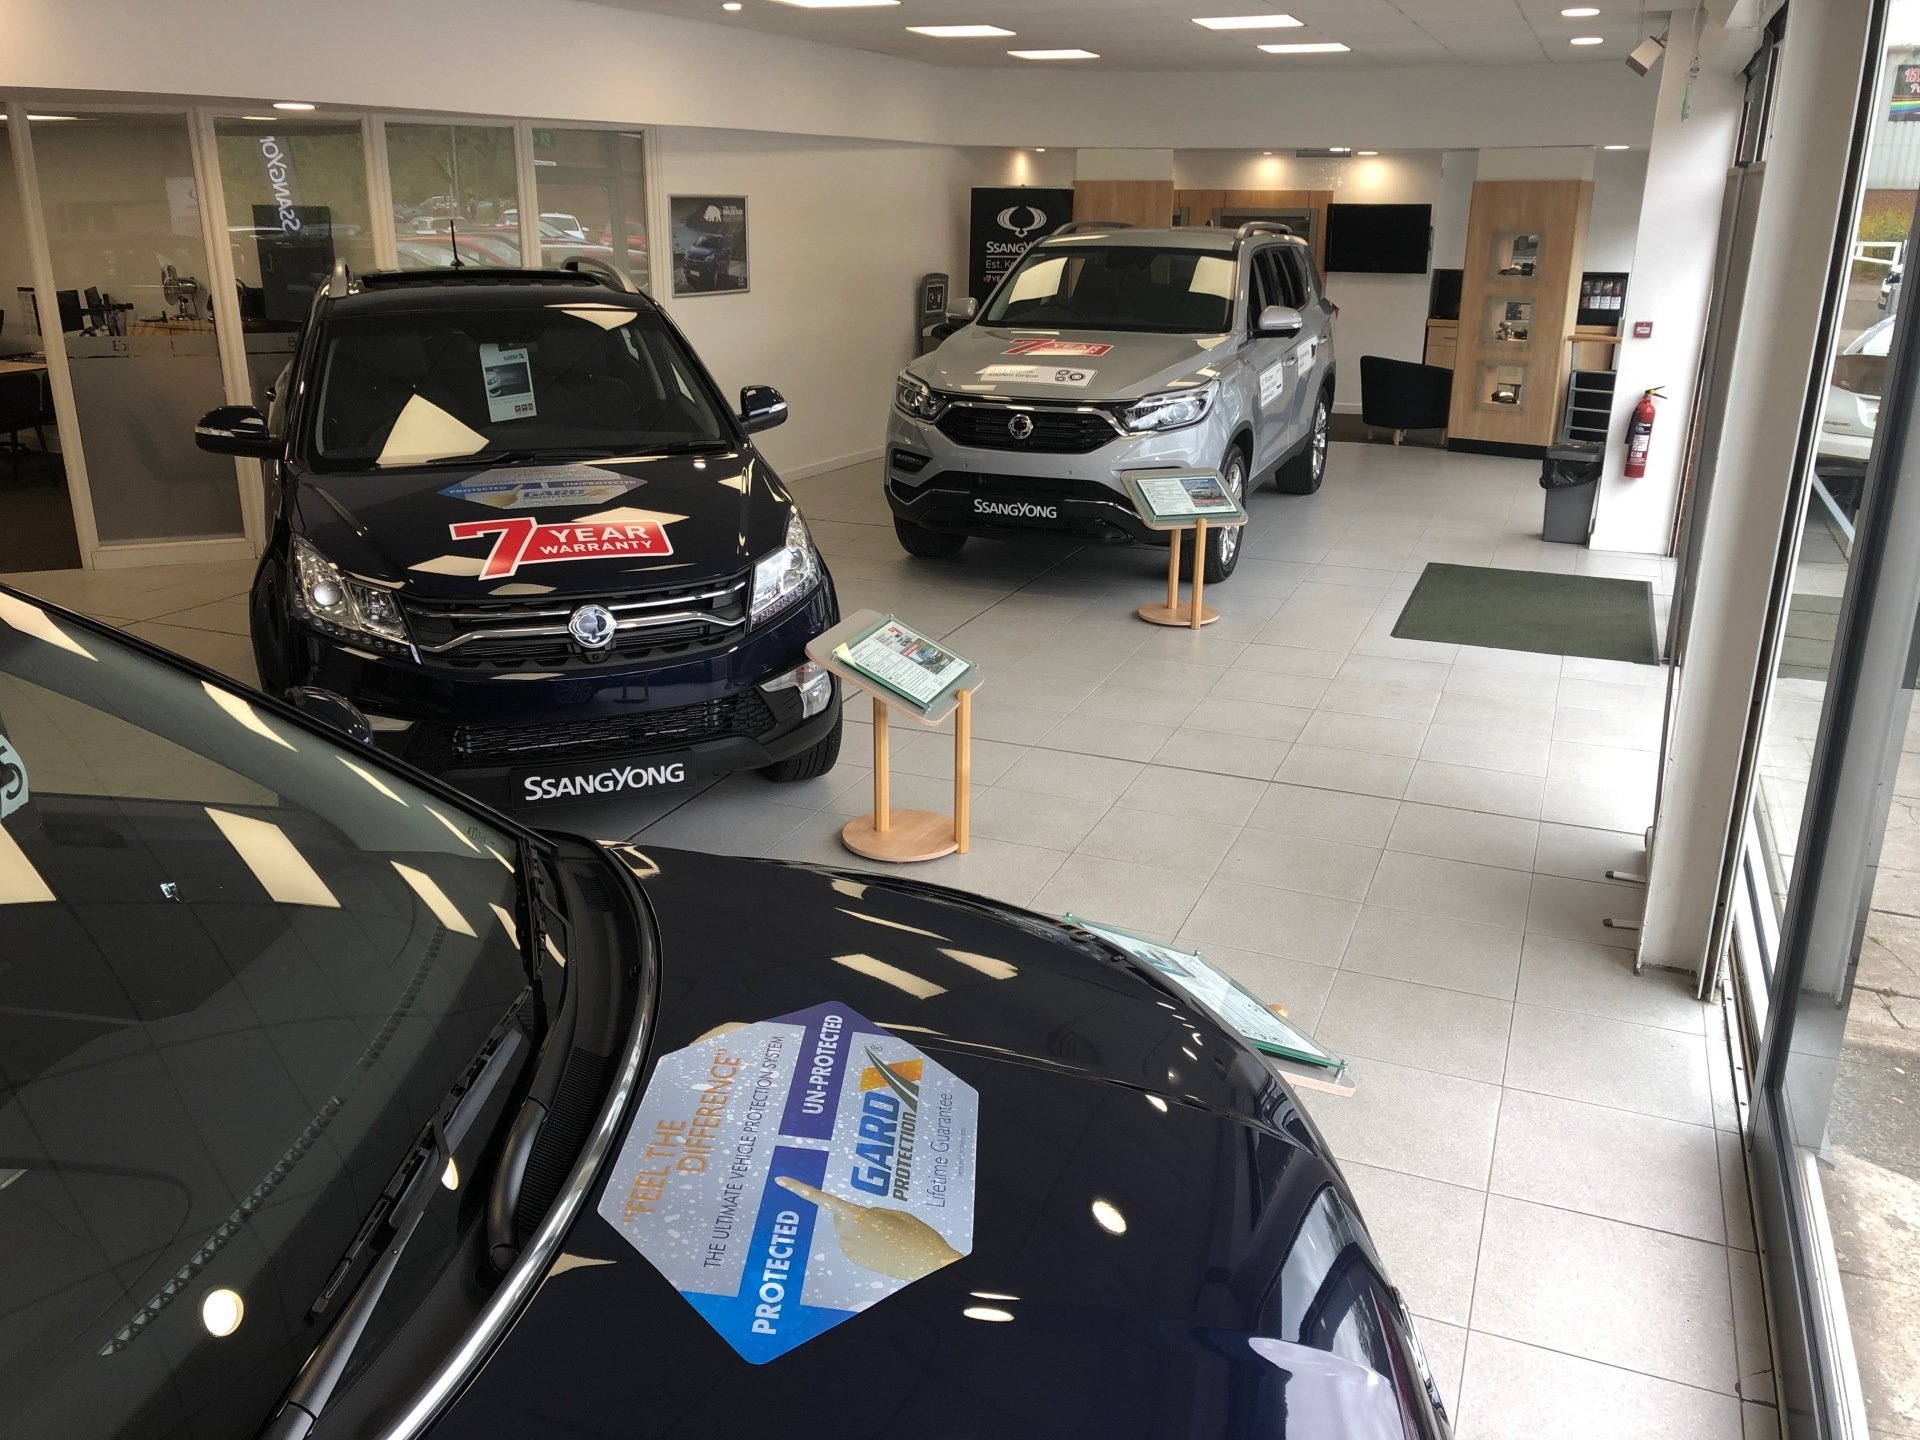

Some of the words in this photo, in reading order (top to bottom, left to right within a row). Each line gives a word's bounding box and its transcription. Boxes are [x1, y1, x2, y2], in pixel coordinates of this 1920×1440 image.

[449, 485, 507, 494] PROTECTED
[449, 517, 537, 581] 7
[549, 525, 651, 543] YEAR
[539, 540, 653, 555] WARRANTY
[763, 1035, 785, 1070] SYSTEM
[802, 1014, 843, 1115] UN-PROTECTED
[745, 1070, 773, 1133] PROTECTION
[931, 1093, 953, 1153] Guarantee
[644, 1119, 686, 1160] THE
[730, 1136, 757, 1180] VEHICLE
[893, 1111, 917, 1202] PROTECTION
[926, 1157, 948, 1208] Lifetime
[712, 1183, 743, 1240] ULTIMATE
[703, 1243, 726, 1267] THE
[751, 1210, 800, 1335] PROTECTED
